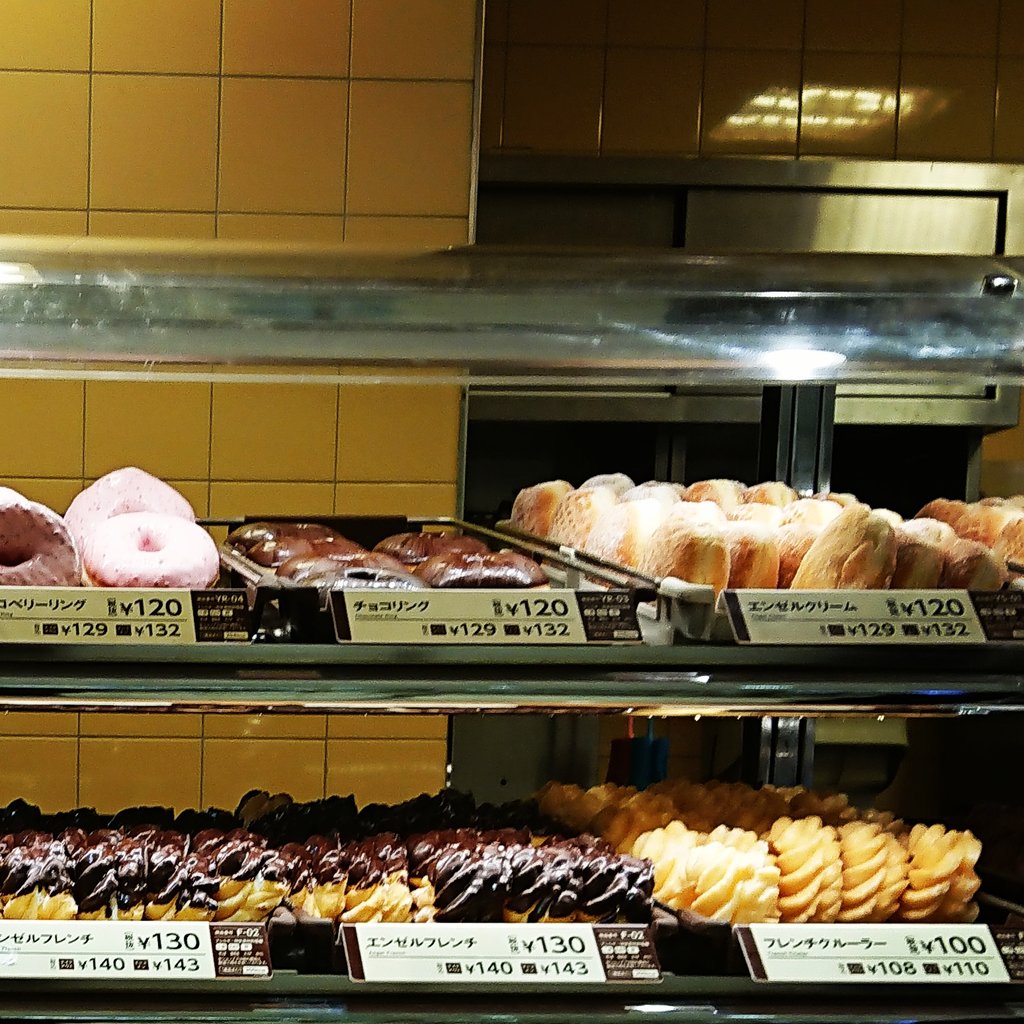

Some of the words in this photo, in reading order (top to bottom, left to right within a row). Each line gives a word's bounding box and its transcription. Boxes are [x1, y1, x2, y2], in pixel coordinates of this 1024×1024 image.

[120, 598, 183, 617] ¥120
[505, 599, 569, 617] ¥120
[900, 598, 965, 617] ¥120
[61, 622, 108, 637] ¥129
[134, 623, 182, 637] ¥132
[449, 622, 496, 637] ¥129
[522, 623, 571, 637] ¥132
[847, 622, 895, 637] ¥129
[138, 932, 201, 951] ¥130
[366, 936, 478, 949] エンゼルフレンチ
[521, 935, 586, 954] ¥130
[763, 937, 888, 950] フレンチクルーラー
[919, 935, 987, 955] ¥100
[77, 957, 126, 971] ¥140
[152, 958, 200, 972] ¥143
[465, 961, 513, 975] ¥140
[539, 961, 590, 976] ¥143
[866, 960, 918, 976] ¥108
[943, 960, 990, 976] ¥110
